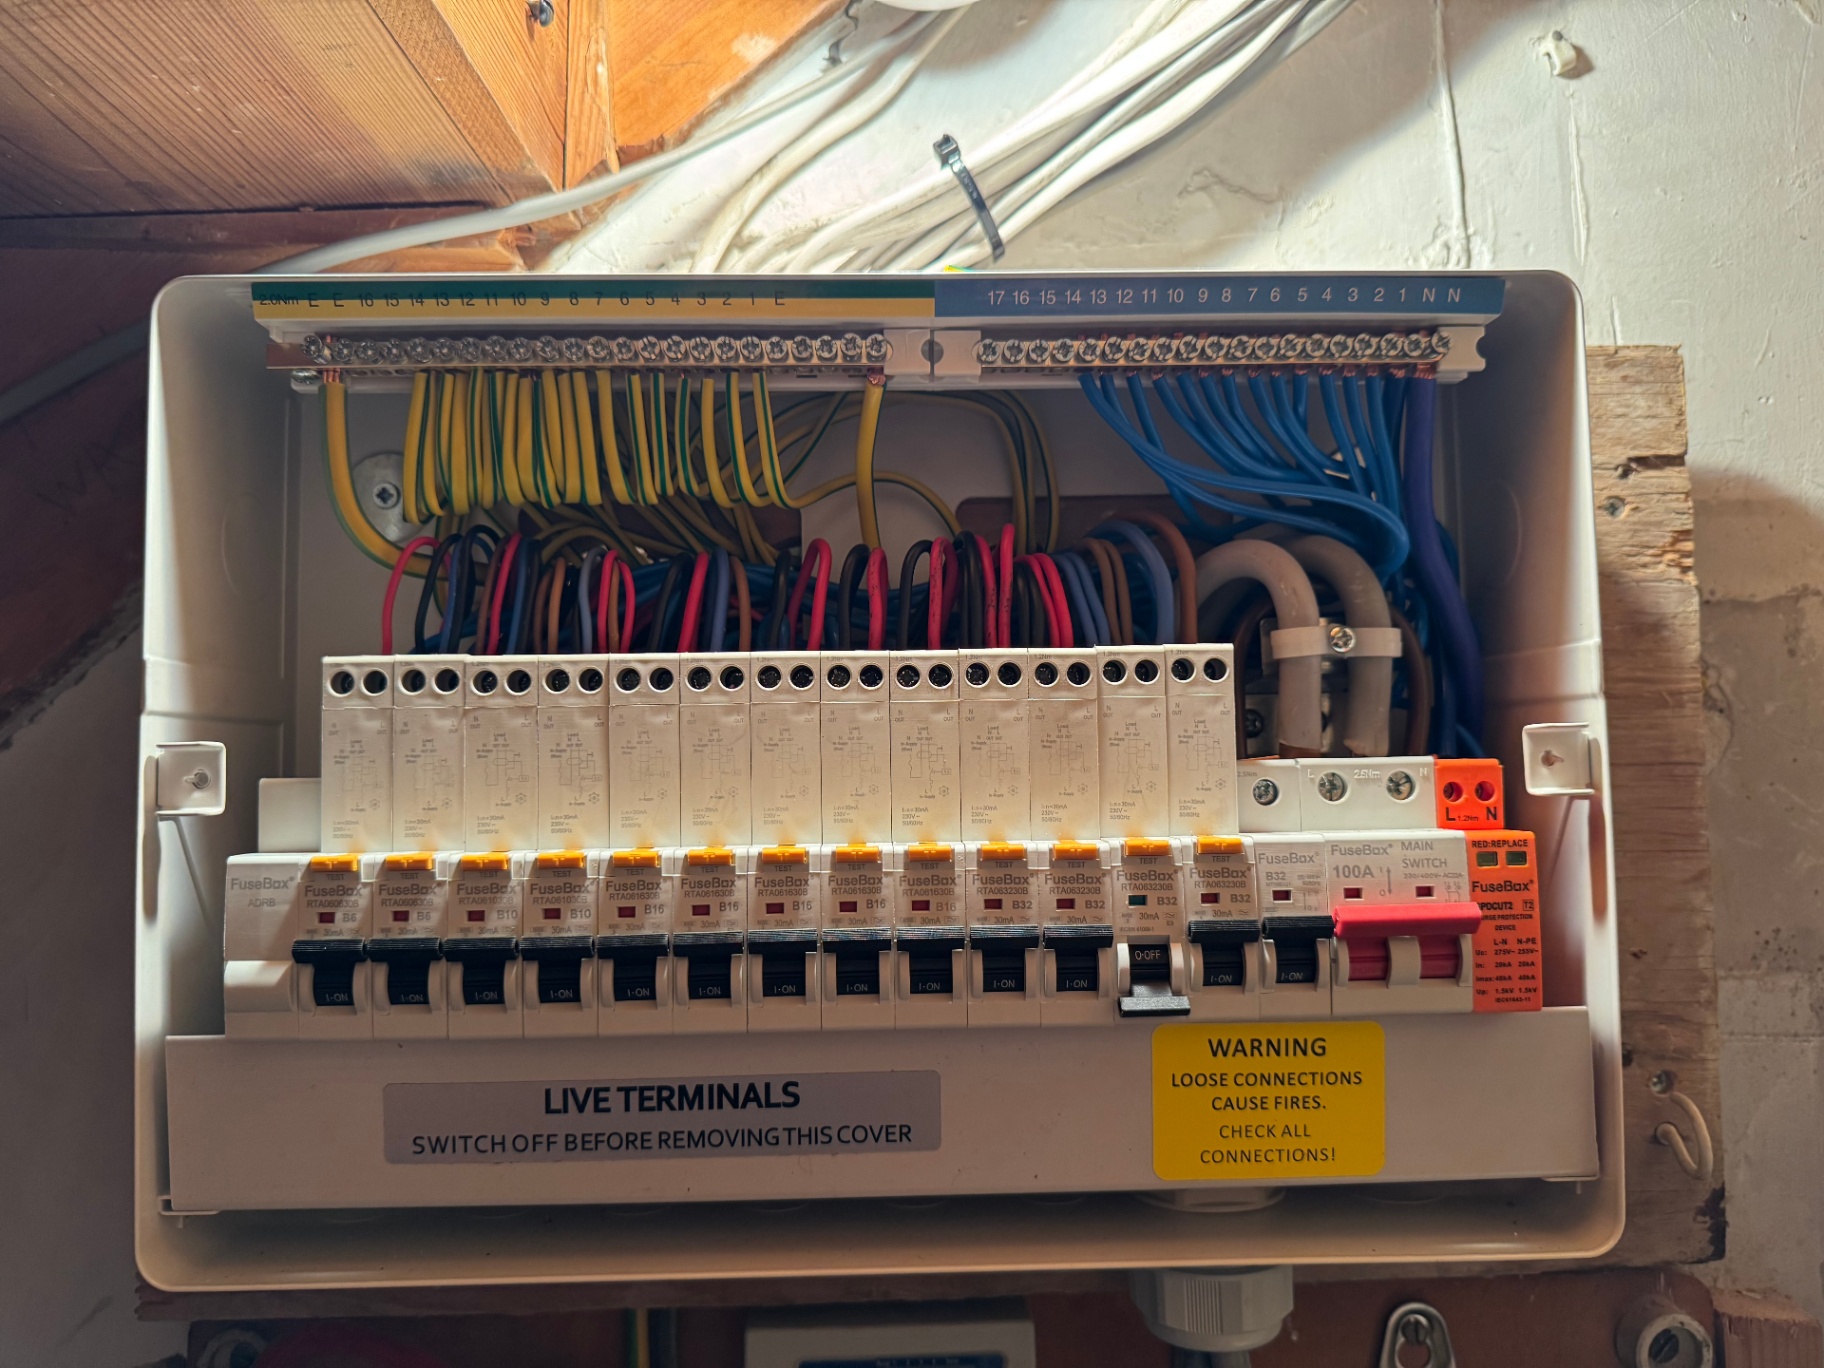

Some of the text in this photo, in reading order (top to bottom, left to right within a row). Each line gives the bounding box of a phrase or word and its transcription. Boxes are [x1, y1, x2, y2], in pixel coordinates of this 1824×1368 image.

[308, 292, 319, 307] E
[333, 292, 344, 308] E
[358, 292, 374, 307] 16
[383, 292, 399, 306] 15
[408, 292, 425, 306] 14
[434, 292, 450, 306] 13
[458, 292, 476, 306] 12
[484, 292, 498, 306] 11
[510, 292, 526, 306] 10
[540, 292, 550, 306] 9
[569, 292, 580, 306] 8
[594, 292, 604, 306] 7
[620, 292, 630, 306] 6
[645, 292, 655, 306] 5
[671, 292, 681, 306] 4
[696, 292, 706, 306] 3
[722, 292, 732, 306] 2
[750, 292, 756, 306] 1
[774, 292, 786, 306] E
[988, 287, 1461, 305] 17 16 15 14 13 12 11 10 9 8 7 6 5 4 3 2 1 N N
[1446, 807, 1456, 821] L
[1486, 807, 1497, 820] N
[1401, 841, 1433, 850] MAIN
[1472, 839, 1528, 848] RED:REPLACE
[1402, 858, 1447, 868] SWITCH
[1266, 872, 1286, 880] B32
[1333, 865, 1375, 878] 100A
[1157, 897, 1178, 906] B32
[1230, 894, 1251, 903] B32
[720, 902, 739, 911] B16
[793, 901, 812, 910] B16
[867, 899, 886, 908] B16
[936, 902, 956, 911] B16
[1012, 901, 1032, 909] B32
[1085, 901, 1105, 909] B32
[570, 909, 591, 918] B10
[645, 905, 664, 914] B16
[343, 913, 356, 922] B6
[417, 912, 431, 921] B6
[497, 910, 518, 919] B10
[1208, 1037, 1327, 1057] WARNING
[1172, 1071, 1362, 1087] LOOSE CONNECTIONS
[544, 1080, 801, 1115] LIVE TERMINALS
[1212, 1095, 1326, 1110] CAUSE FIRES.
[1219, 1124, 1310, 1138] CHECK ALL
[412, 1124, 912, 1155] SWITCH OFF BEFORE REMOVING THIS COVER
[1200, 1147, 1335, 1163] CONNECTIONS!
